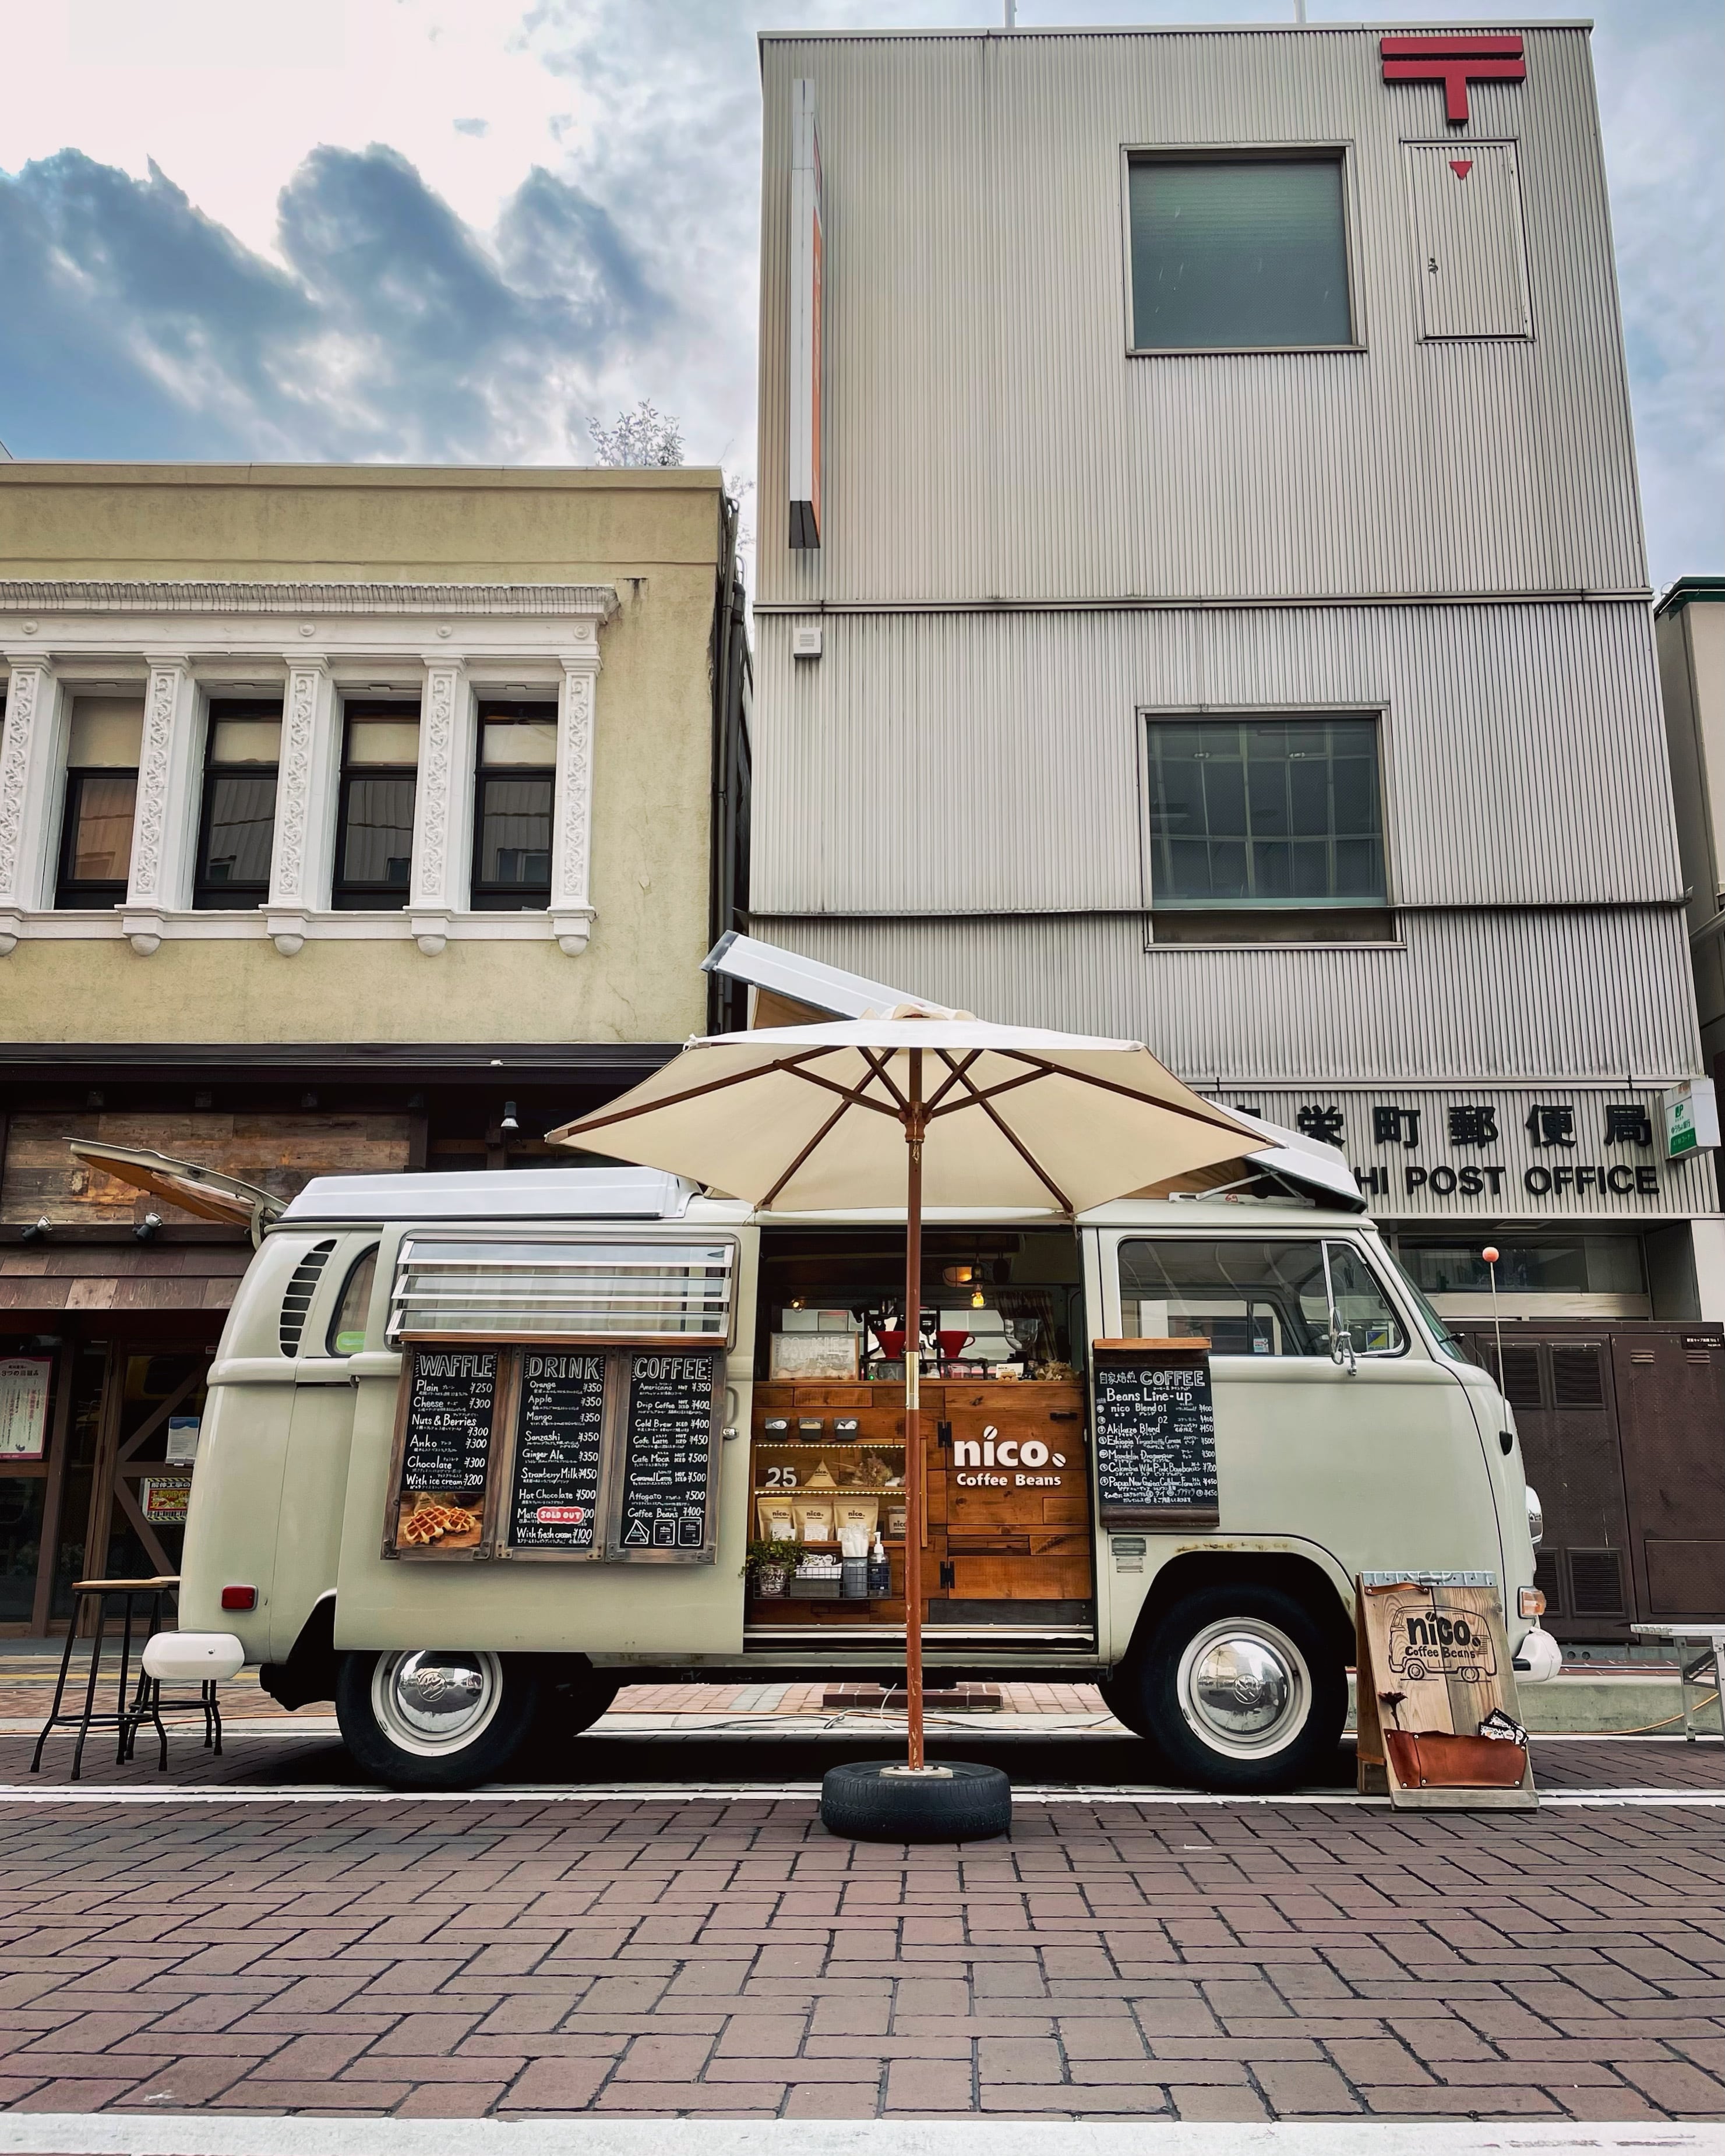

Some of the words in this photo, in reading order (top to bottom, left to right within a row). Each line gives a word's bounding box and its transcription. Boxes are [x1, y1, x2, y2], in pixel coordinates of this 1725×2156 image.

[1236, 1102, 1652, 1148] 栄町郵便局
[1406, 1166, 1506, 1194] POST
[1525, 1166, 1660, 1195] OFFICE
[420, 1355, 494, 1377] WAFFLE
[529, 1357, 599, 1379] DRINK
[634, 1357, 708, 1380] COFFEE
[1140, 1371, 1205, 1386] COFFEE
[417, 1379, 438, 1392] Plain
[470, 1382, 492, 1393] ¥250
[530, 1381, 556, 1389] Orange
[583, 1383, 602, 1392] ¥350
[639, 1382, 672, 1391] Americano
[692, 1382, 711, 1392] ¥350
[414, 1396, 443, 1407] Cheese
[469, 1397, 491, 1409] ¥300
[528, 1394, 552, 1405] Apple
[581, 1397, 601, 1406] ¥350
[1107, 1388, 1140, 1401] Beans
[1144, 1387, 1192, 1406] Line-up
[636, 1401, 652, 1410] Drip
[1111, 1403, 1130, 1412] nico
[1135, 1403, 1156, 1412] Blend
[1158, 1403, 1167, 1412] 01
[412, 1414, 432, 1425] Nuts
[434, 1415, 441, 1425] &
[443, 1414, 477, 1426] Berries
[527, 1412, 552, 1423] Mango
[580, 1413, 600, 1422] ¥350
[635, 1419, 651, 1427] Cold
[654, 1419, 672, 1427] Brew
[690, 1418, 710, 1428] ¥400
[467, 1427, 488, 1437] ¥300
[1140, 1423, 1160, 1433] Blend
[410, 1434, 437, 1447] Anko
[465, 1438, 487, 1449] ¥300
[525, 1430, 560, 1441] Sanzashi
[578, 1432, 599, 1442] ¥350
[633, 1436, 650, 1444] Cafe
[689, 1434, 708, 1445] ¥450
[523, 1449, 548, 1460] Ginger
[549, 1449, 564, 1460] Ale
[578, 1451, 598, 1462] ¥350
[632, 1455, 648, 1463] Cafe
[651, 1454, 669, 1462] Moca
[688, 1453, 707, 1463] ¥500
[408, 1455, 452, 1469] Chocolate
[464, 1457, 485, 1468] ¥300
[1153, 1463, 1168, 1473] Pink
[1202, 1462, 1216, 1473] ¥700
[560, 1467, 578, 1479] Milk
[630, 1473, 655, 1481] Caramel
[656, 1472, 672, 1481] Latte
[688, 1472, 706, 1483] ¥500
[765, 1467, 797, 1487] 25
[957, 1473, 1008, 1485] Coffee
[1015, 1474, 1061, 1485] Beans
[407, 1474, 427, 1485] With
[429, 1476, 440, 1485] ice
[463, 1473, 483, 1486] ¥200
[1109, 1476, 1129, 1489] Papua
[1128, 1477, 1142, 1486] New
[1203, 1478, 1217, 1486] ¥450
[519, 1488, 534, 1499] Hot
[536, 1488, 573, 1499] Chocolate
[576, 1489, 596, 1500] ¥500
[629, 1491, 662, 1502] Affogato
[685, 1490, 705, 1501] ¥500
[627, 1508, 653, 1518] Coffee
[657, 1508, 678, 1518] Beans
[517, 1527, 536, 1539] With
[537, 1527, 554, 1539] fresh
[573, 1529, 592, 1540] ¥100
[1405, 1646, 1438, 1657] Coffee
[1443, 1647, 1476, 1659] Beans
